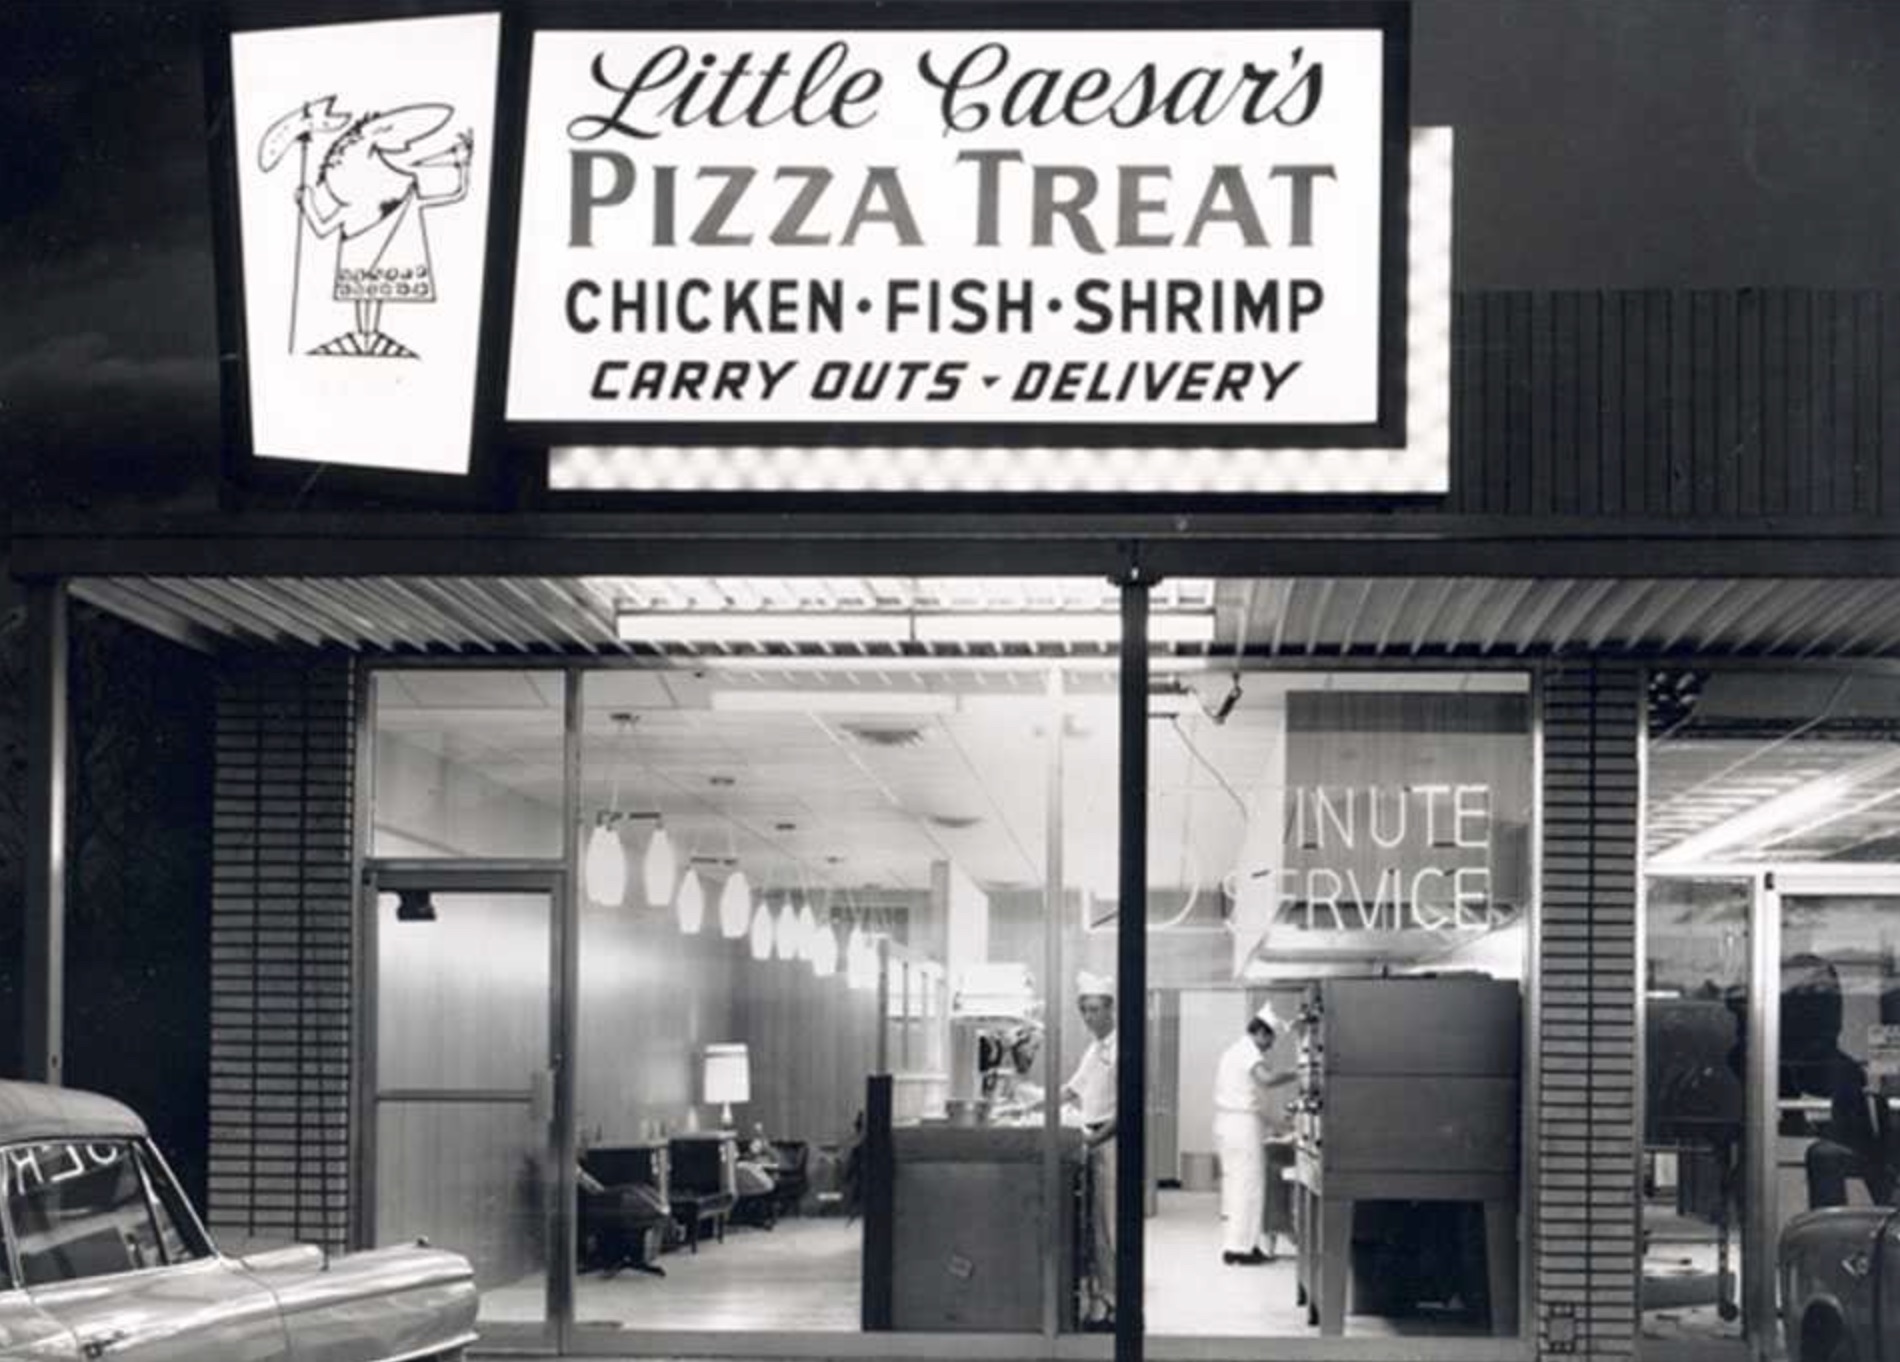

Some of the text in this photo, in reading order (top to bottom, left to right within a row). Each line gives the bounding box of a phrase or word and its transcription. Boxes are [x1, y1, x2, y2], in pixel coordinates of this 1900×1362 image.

[566, 40, 1325, 141] Little Caesar's
[565, 278, 1325, 335] CHICKEN FISH SHRIMP
[590, 360, 1303, 402] CARRY OUTS DELIVERY
[1294, 784, 1491, 849] INUTE
